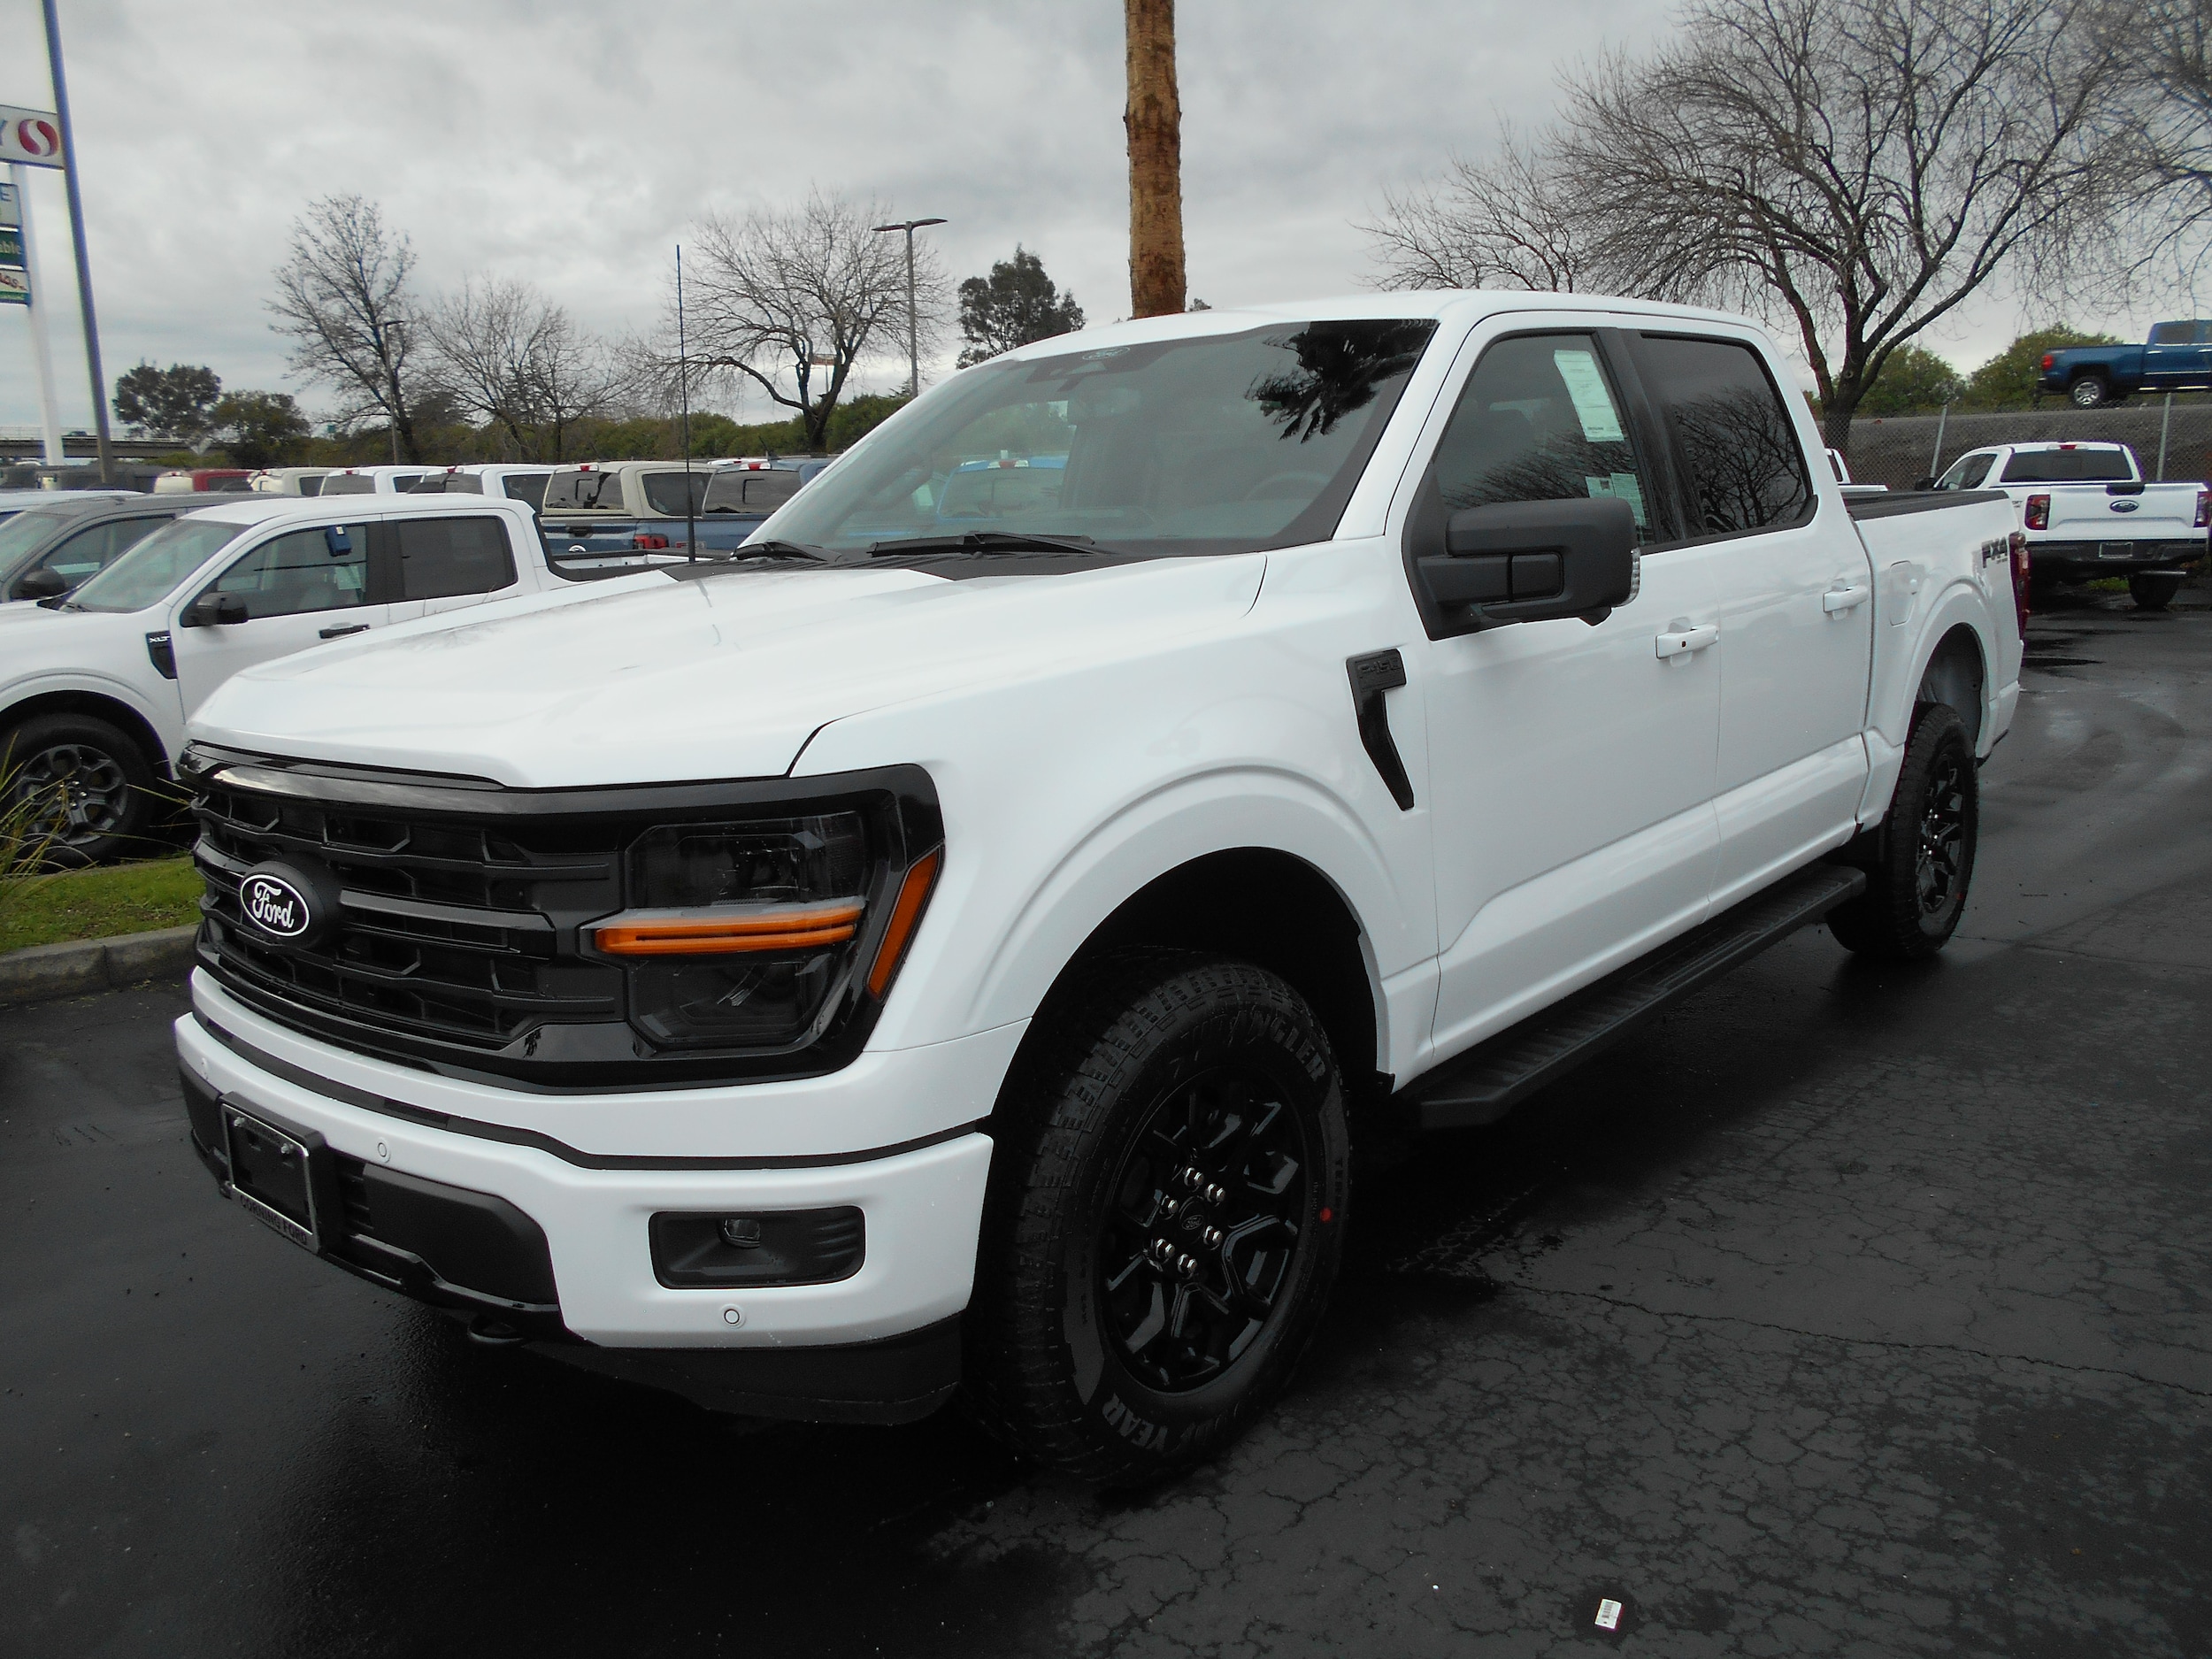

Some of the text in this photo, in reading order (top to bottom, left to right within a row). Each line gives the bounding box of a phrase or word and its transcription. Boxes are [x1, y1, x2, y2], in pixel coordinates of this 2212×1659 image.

[1981, 536, 2008, 568] FX4
[252, 881, 295, 928] Ford
[240, 1194, 307, 1245] CORNING FORD
